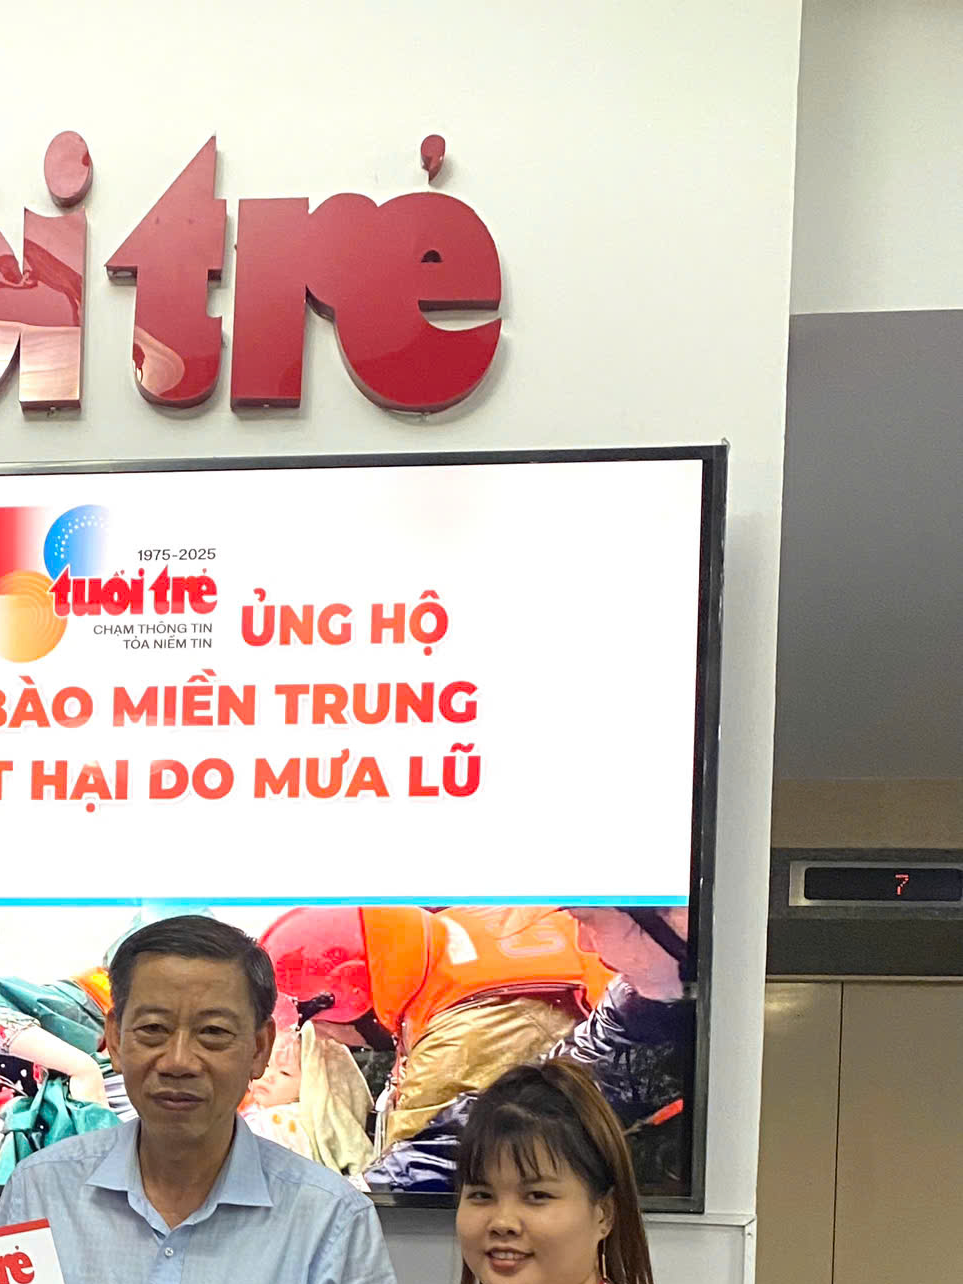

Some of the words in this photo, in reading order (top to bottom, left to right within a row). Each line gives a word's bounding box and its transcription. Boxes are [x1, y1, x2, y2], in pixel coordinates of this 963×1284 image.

[103, 132, 503, 417] trẻ
[137, 548, 217, 562] 1975-2025
[149, 564, 218, 616] trẻ
[93, 624, 135, 637] CHẠM
[137, 621, 188, 635] THÔNG
[190, 623, 213, 634] TIN
[190, 638, 212, 649] TIN
[241, 587, 353, 647] ỦNG
[370, 590, 449, 656] HỘ
[112, 668, 256, 727] MIỀN
[275, 681, 478, 725] TRUNG
[30, 759, 129, 813] HẠI
[149, 757, 235, 800] DO
[254, 748, 390, 799] MƯA
[408, 742, 481, 798] LŨ
[895, 874, 909, 895] 7
